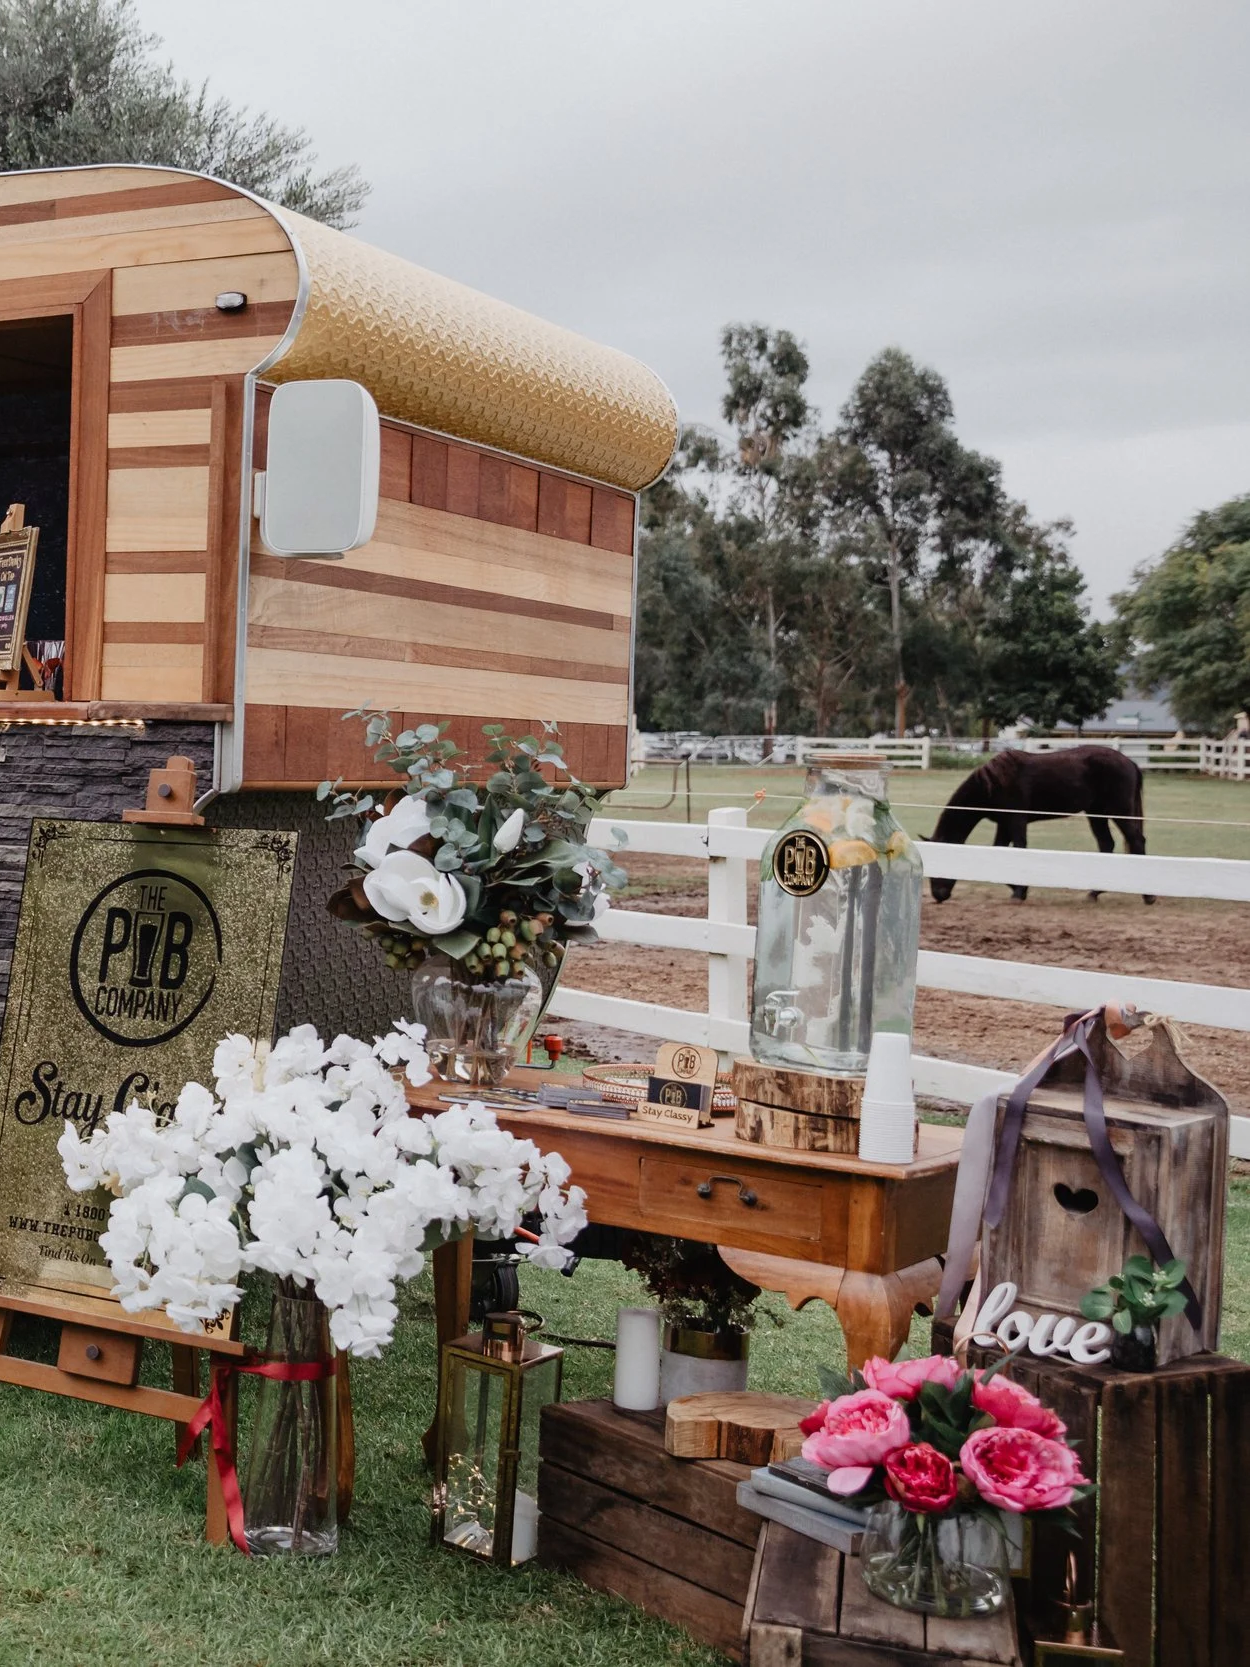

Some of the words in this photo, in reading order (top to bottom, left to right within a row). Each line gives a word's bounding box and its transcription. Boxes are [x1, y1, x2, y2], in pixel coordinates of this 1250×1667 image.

[140, 885, 168, 911] THE
[94, 985, 184, 1023] COMPANY
[14, 1061, 105, 1140] Stay
[642, 1106, 662, 1119] Stay
[664, 1110, 693, 1124] Classy
[75, 1204, 112, 1221] 1800
[38, 1244, 63, 1260] Find
[81, 1254, 96, 1266] On
[973, 1281, 1111, 1365] love
